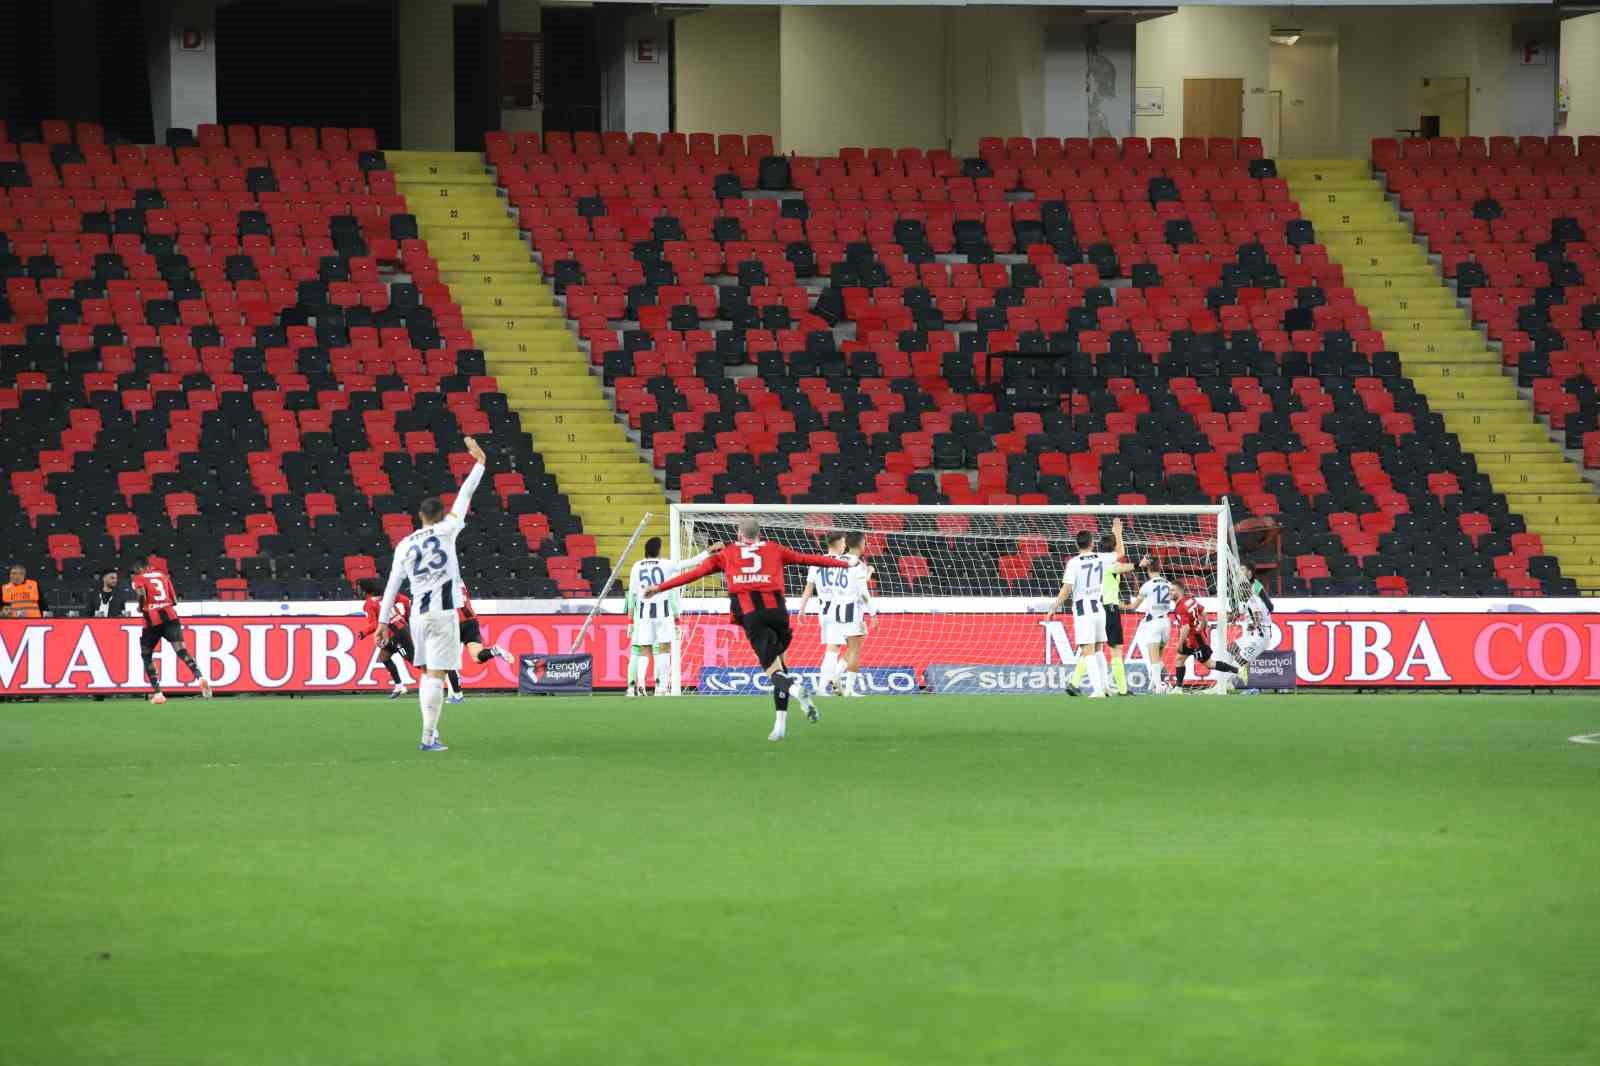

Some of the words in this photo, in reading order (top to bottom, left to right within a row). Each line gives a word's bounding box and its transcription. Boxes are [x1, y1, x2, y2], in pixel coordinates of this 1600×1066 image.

[183, 30, 201, 49] D
[638, 35, 655, 61] E
[1524, 40, 1540, 63] F
[405, 535, 448, 576] 23
[740, 546, 762, 574] 5
[639, 566, 665, 588] 50
[149, 578, 167, 601] 3
[1152, 584, 1171, 604] 12
